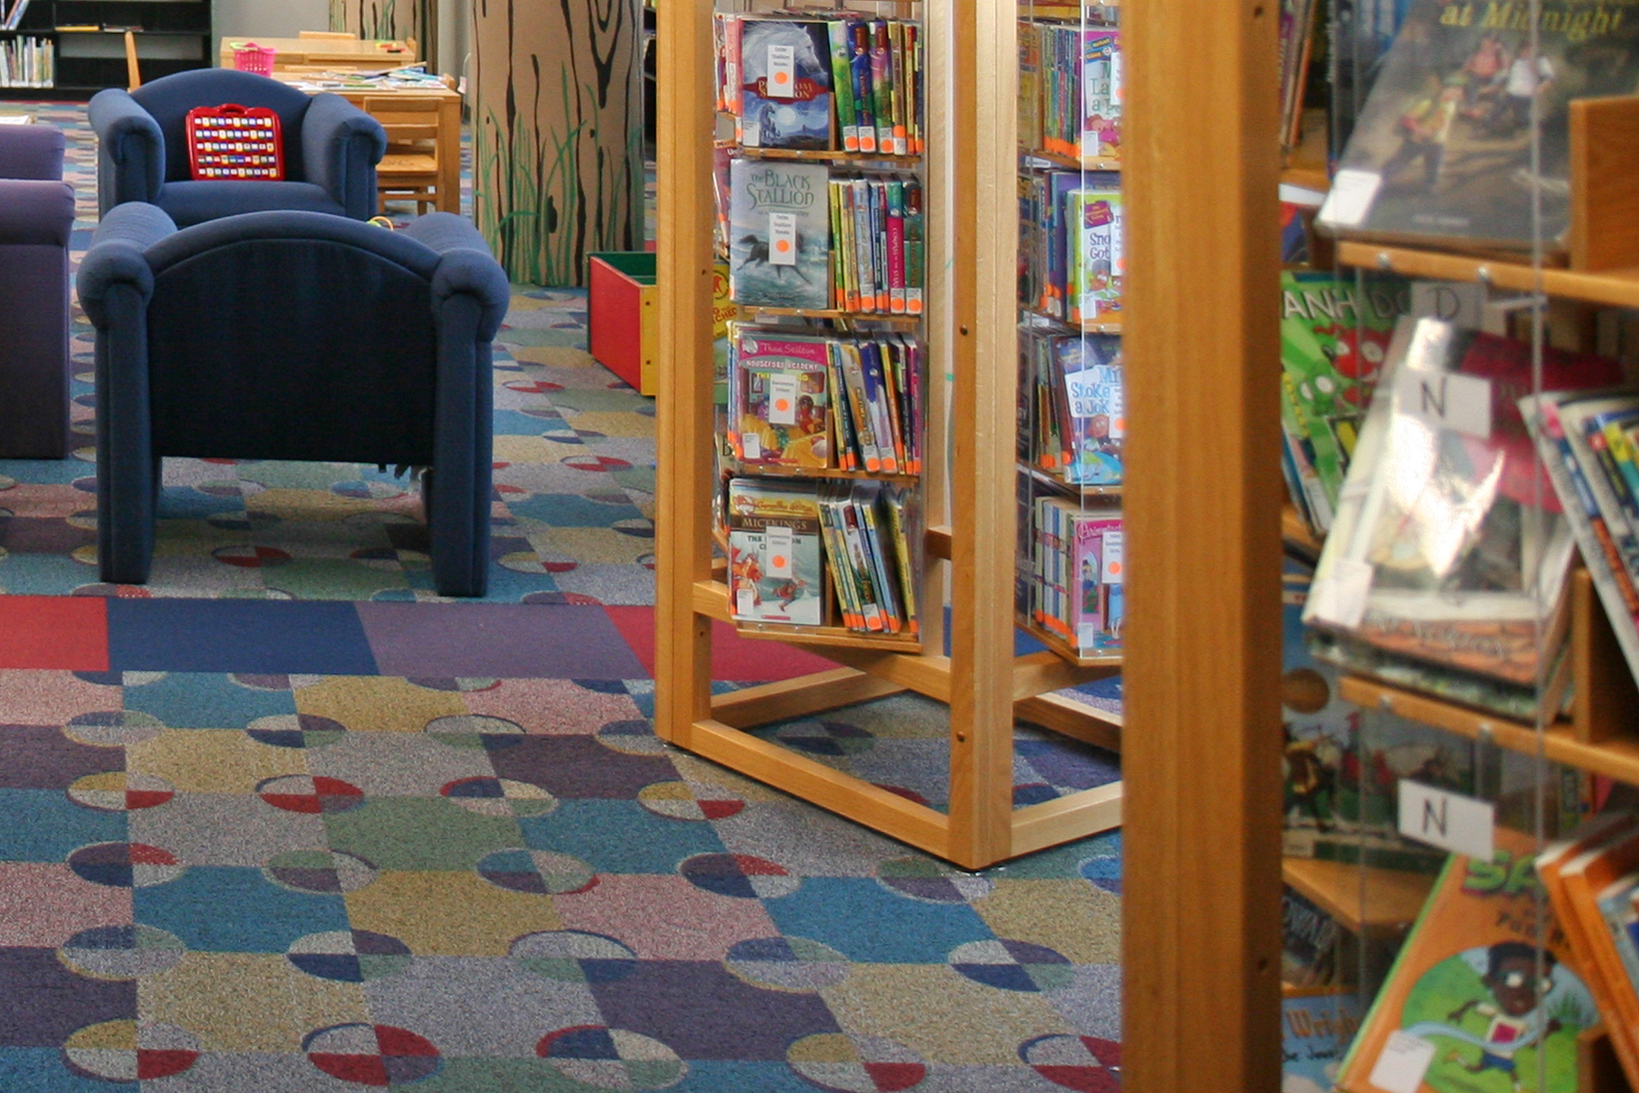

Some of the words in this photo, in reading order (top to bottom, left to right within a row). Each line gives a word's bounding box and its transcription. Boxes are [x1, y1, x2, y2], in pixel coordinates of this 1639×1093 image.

[747, 183, 814, 210] STALLION
[1283, 290, 1356, 320] ANH
[1420, 377, 1447, 419] N
[1423, 797, 1448, 837] N
